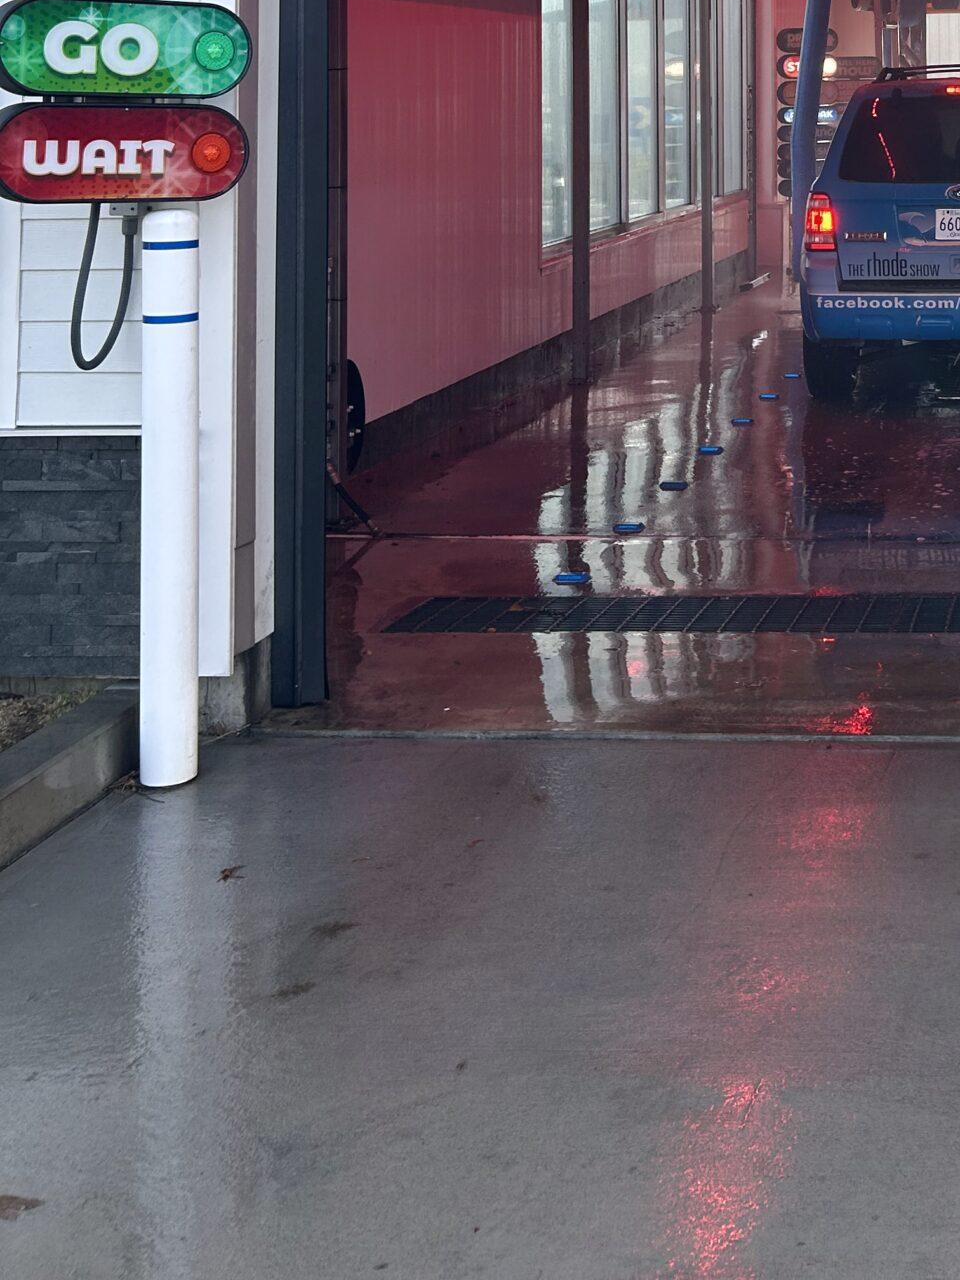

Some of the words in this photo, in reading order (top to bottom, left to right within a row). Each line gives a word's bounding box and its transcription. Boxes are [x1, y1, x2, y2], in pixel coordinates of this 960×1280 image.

[43, 19, 160, 78] GO
[22, 139, 176, 178] WAIT
[847, 263, 863, 277] THE
[867, 251, 908, 278] rhode
[909, 263, 941, 277] SHOW
